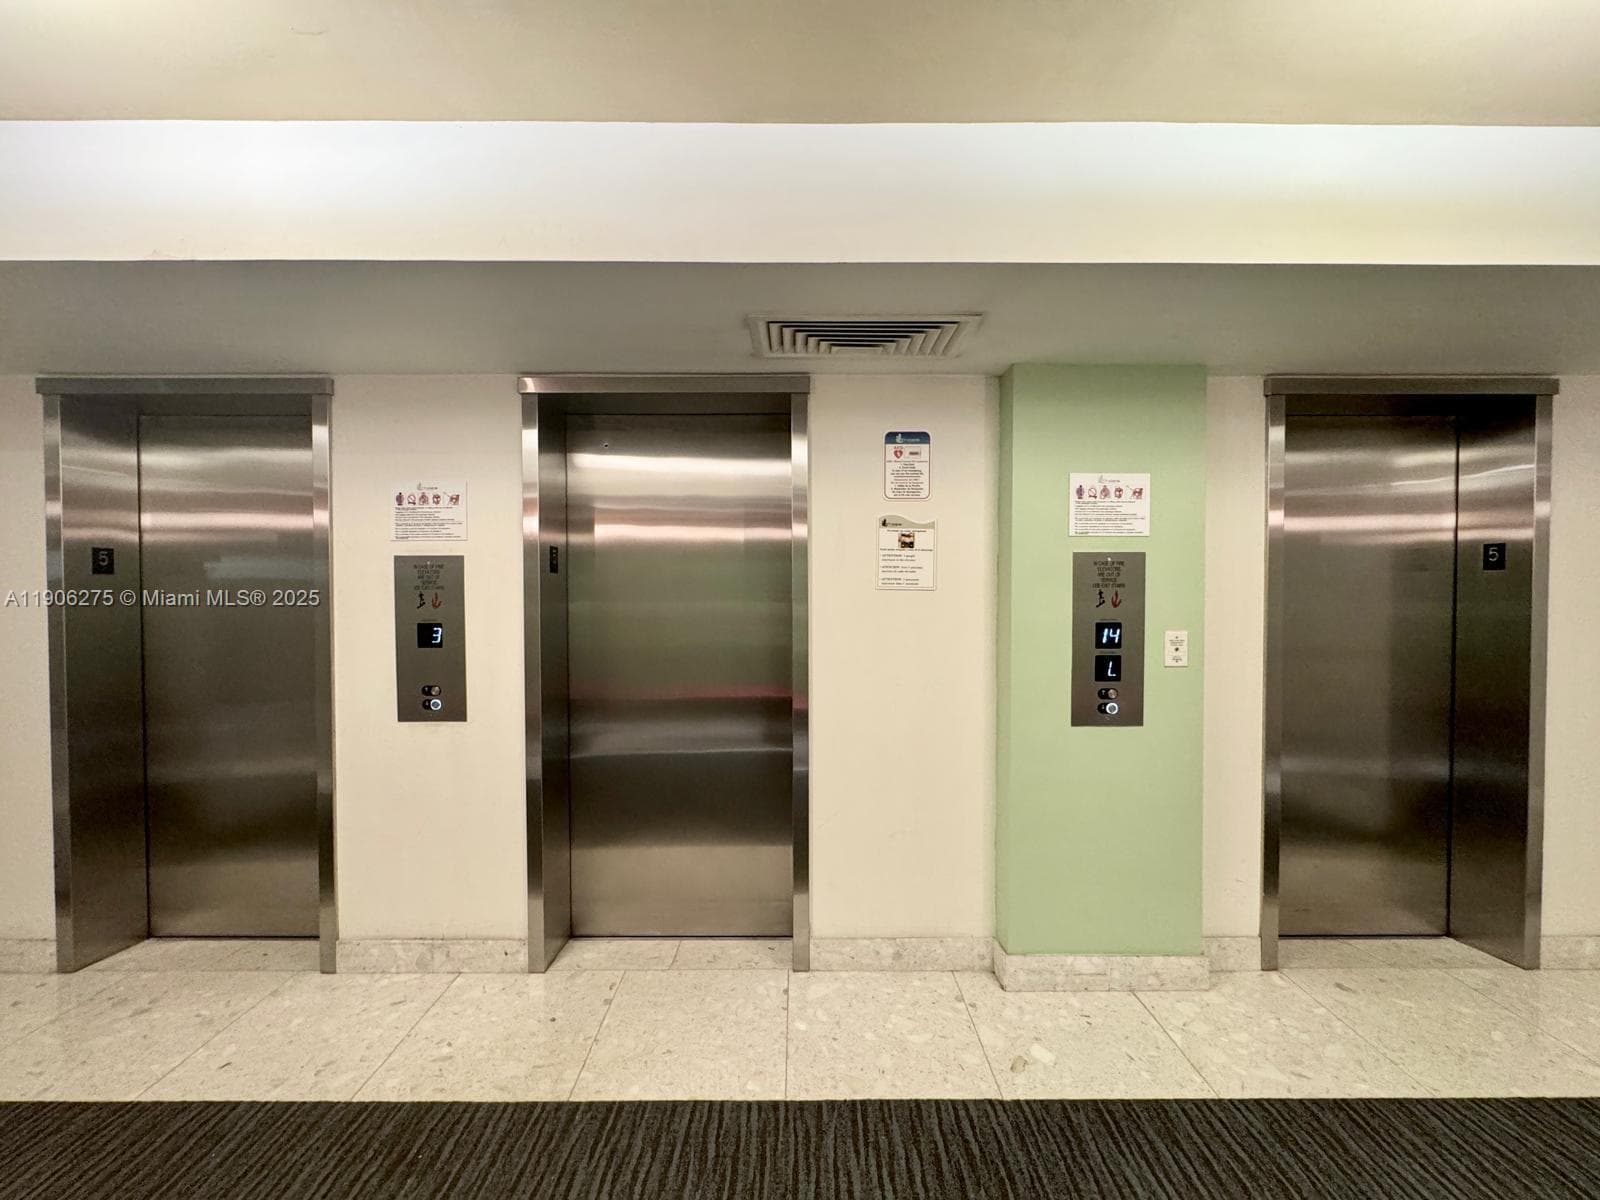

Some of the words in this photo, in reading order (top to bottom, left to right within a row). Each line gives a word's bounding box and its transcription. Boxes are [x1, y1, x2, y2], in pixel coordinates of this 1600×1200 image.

[99, 551, 108, 566] 5
[1488, 547, 1500, 562] 5
[431, 627, 442, 643] 3
[1102, 628, 1120, 644] 14
[1107, 661, 1117, 677] L
